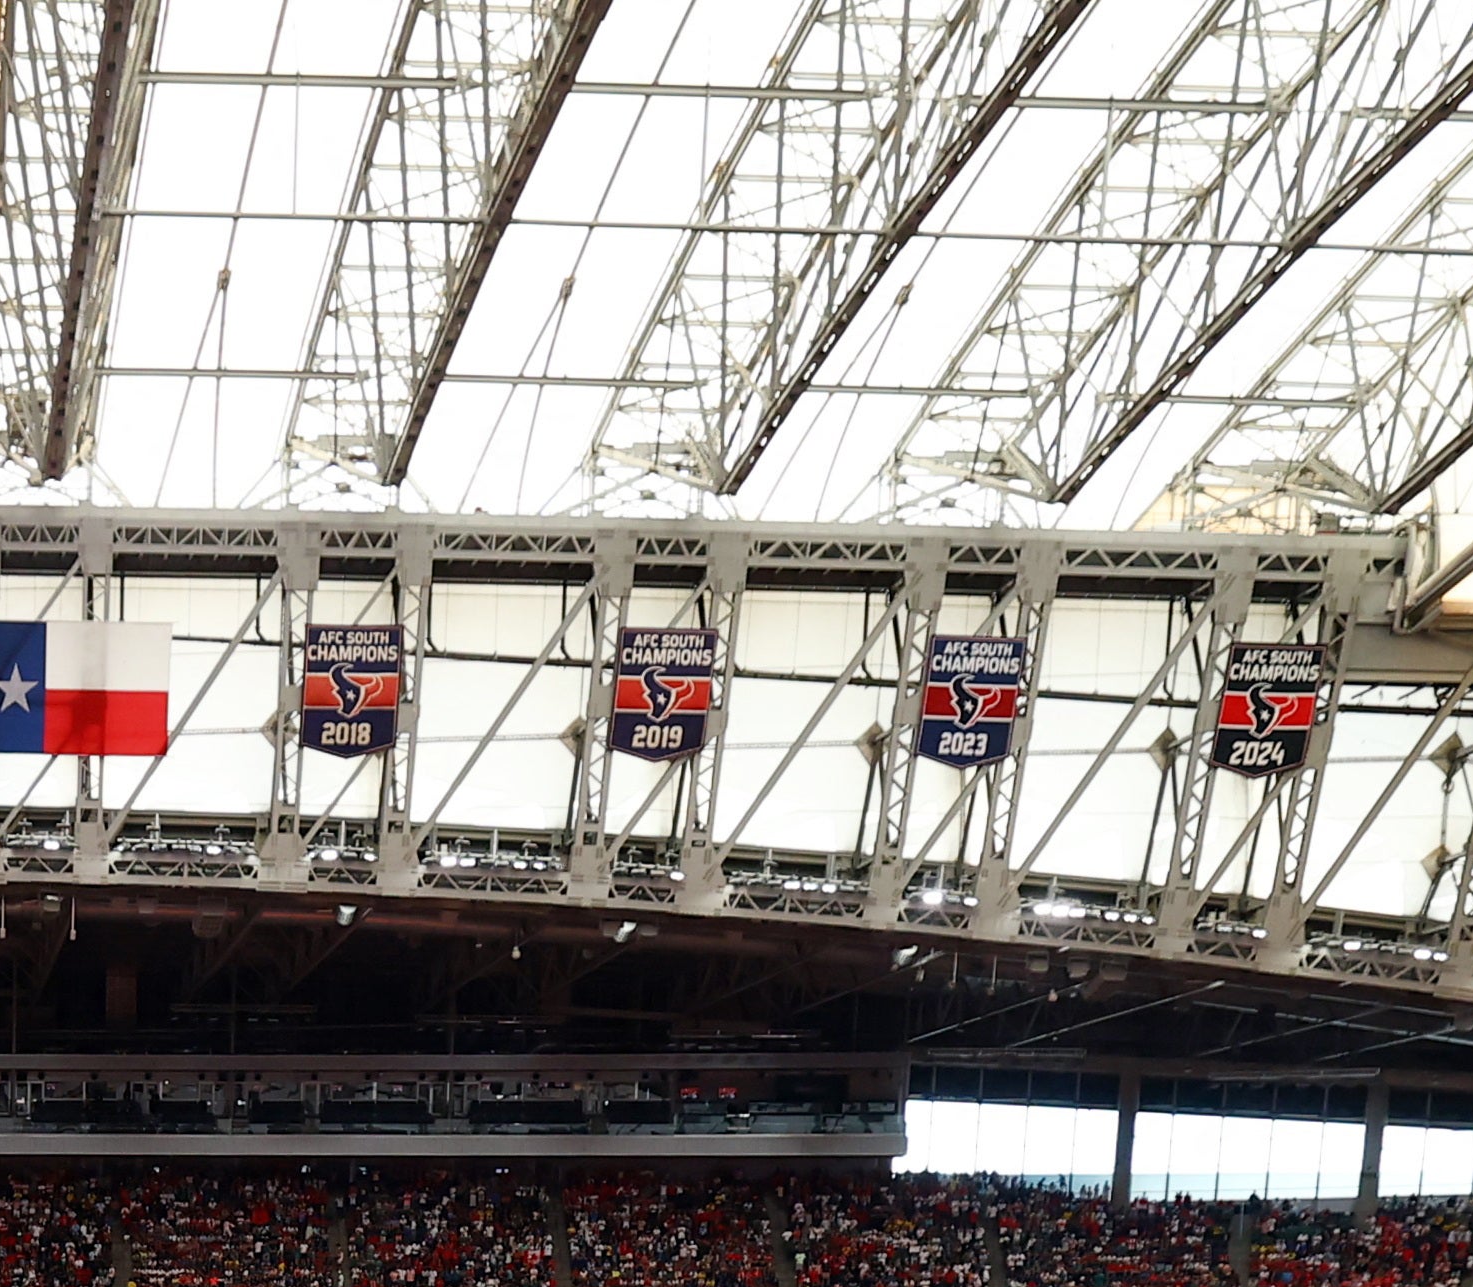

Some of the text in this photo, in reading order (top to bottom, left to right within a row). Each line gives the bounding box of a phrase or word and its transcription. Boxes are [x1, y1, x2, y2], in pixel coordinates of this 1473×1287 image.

[318, 630, 389, 645] AFC SOUTH
[633, 633, 704, 648] AFC SOUTH
[308, 645, 398, 663] CHAMPIONS
[622, 648, 713, 667] CHAMPIONS
[944, 642, 1013, 656] AFC SOUTH
[1242, 650, 1313, 664] AFC SOUTH
[932, 655, 1020, 675] CHAMPIONS
[1229, 663, 1320, 682] CHAMPIONS
[321, 721, 371, 746] 2018
[631, 724, 683, 749] 2019
[938, 731, 988, 757] 2023
[1229, 740, 1285, 766] 2024
